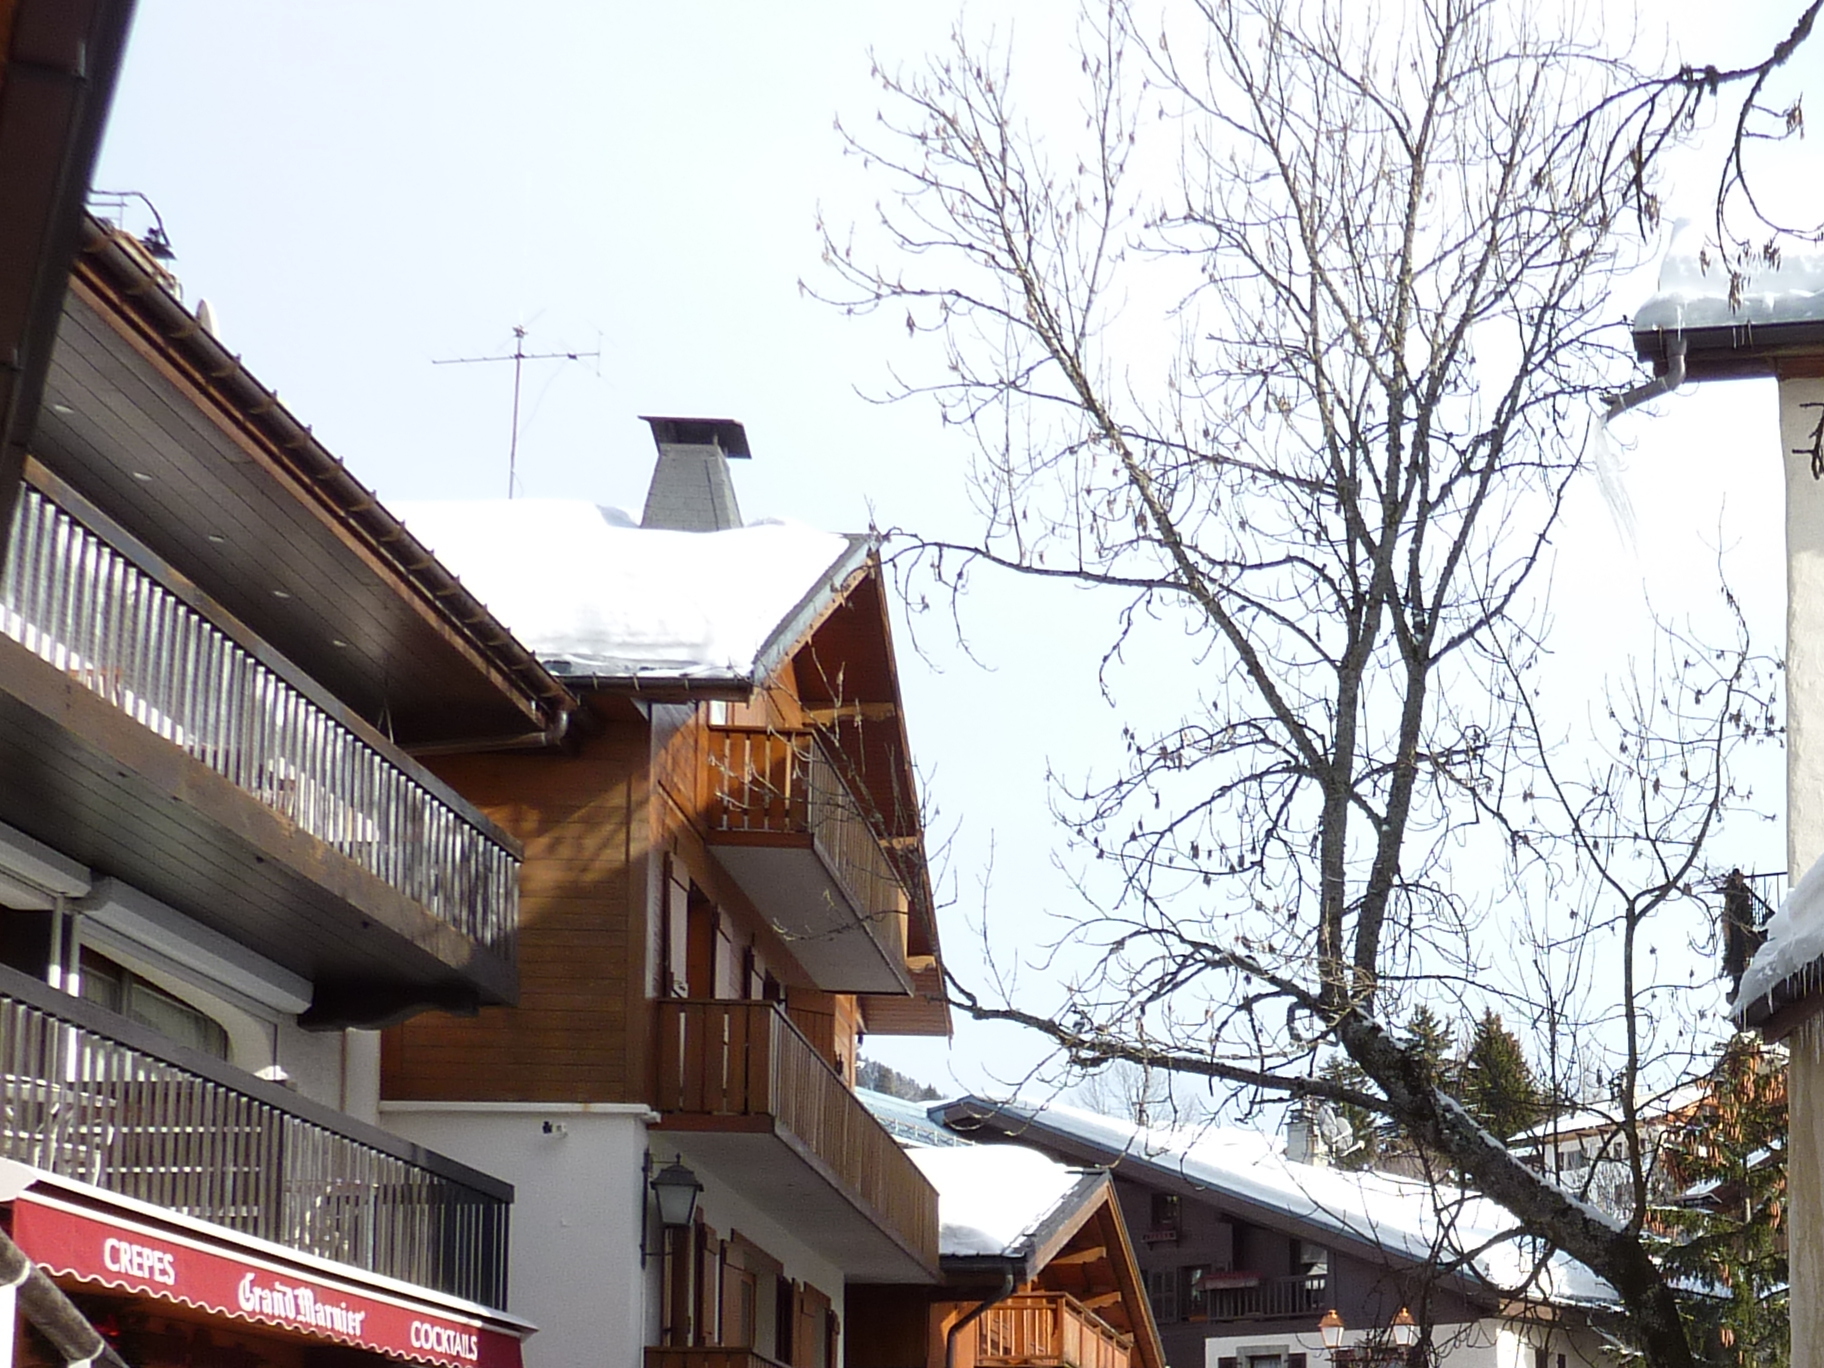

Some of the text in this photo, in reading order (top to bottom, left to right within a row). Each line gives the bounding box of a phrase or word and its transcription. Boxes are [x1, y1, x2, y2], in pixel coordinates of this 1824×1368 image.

[103, 1237, 176, 1286] CREPES
[237, 1271, 365, 1337] Grand Marnier
[410, 1320, 479, 1362] COCKTAILS
